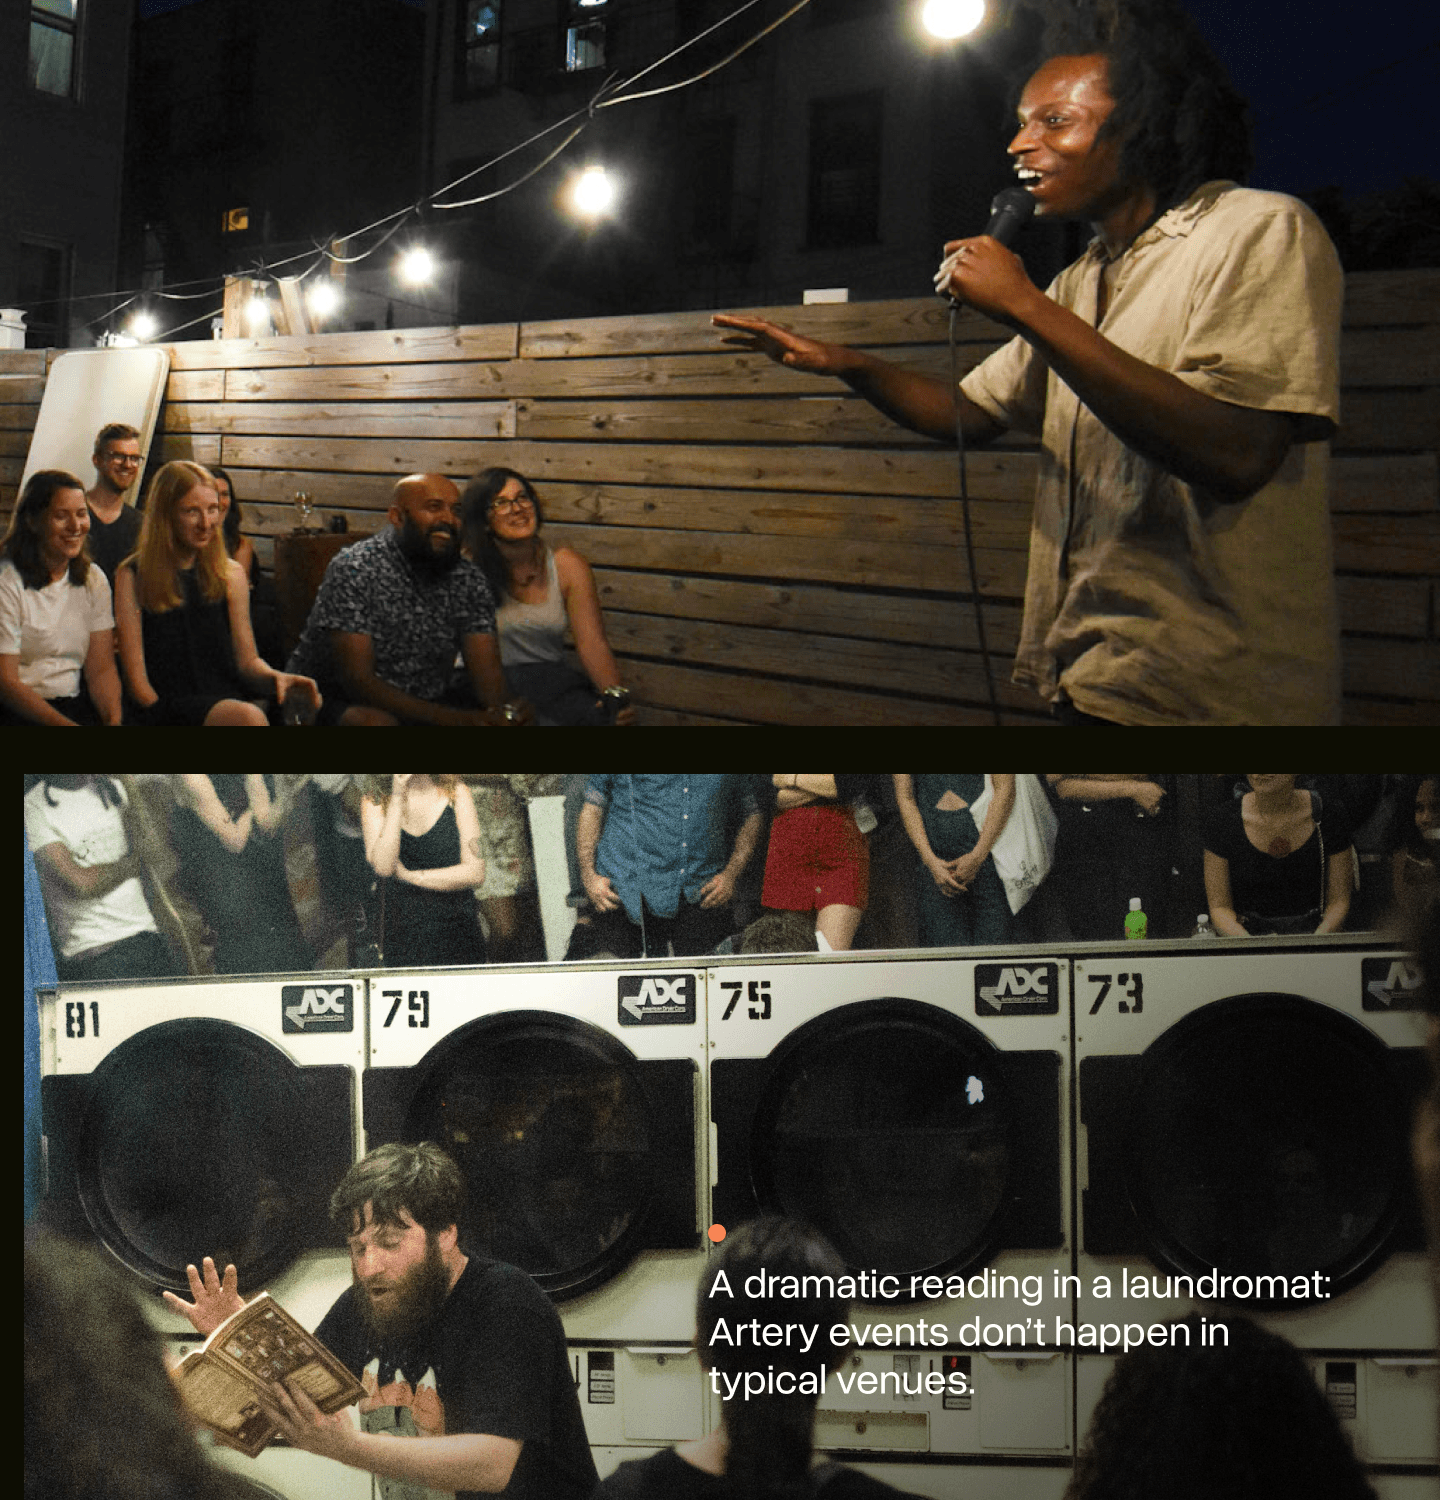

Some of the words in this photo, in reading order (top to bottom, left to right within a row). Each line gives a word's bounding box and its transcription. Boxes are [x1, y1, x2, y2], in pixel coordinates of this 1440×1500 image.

[637, 977, 687, 1006] ADC
[995, 966, 1049, 996] ADC
[1087, 972, 1143, 1015] 73
[66, 1001, 100, 1038] 81
[299, 987, 345, 1015] ADC
[382, 990, 430, 1029] 79
[720, 981, 772, 1021] 75
